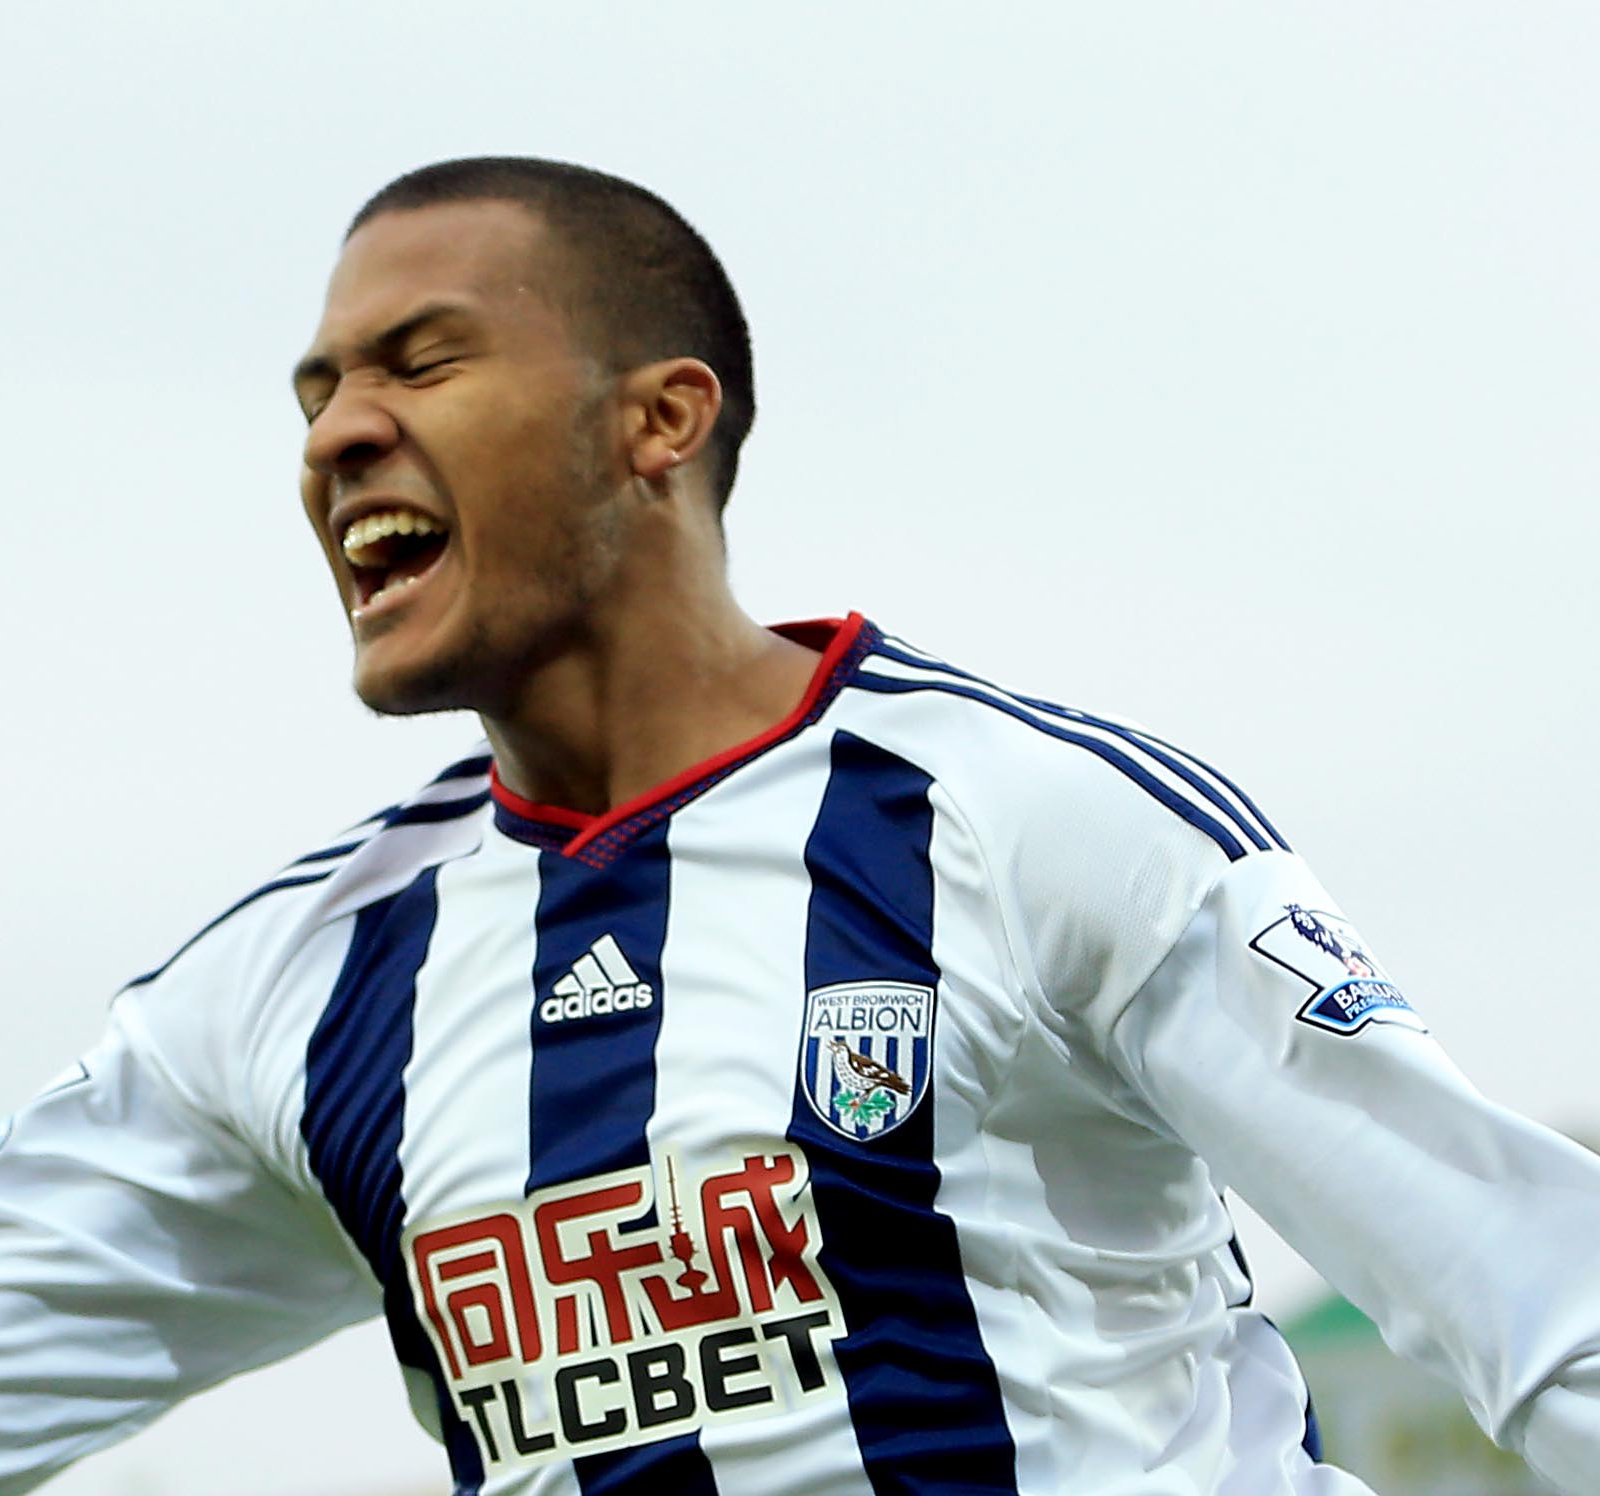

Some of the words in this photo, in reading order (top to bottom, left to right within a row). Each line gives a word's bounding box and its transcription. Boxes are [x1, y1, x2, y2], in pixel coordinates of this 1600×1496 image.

[540, 983, 653, 1023] adidas
[819, 995, 851, 1006] WEST
[853, 994, 924, 1006] BROMWICH
[814, 1006, 922, 1032] ALBION
[459, 1310, 830, 1462] TLCBET
